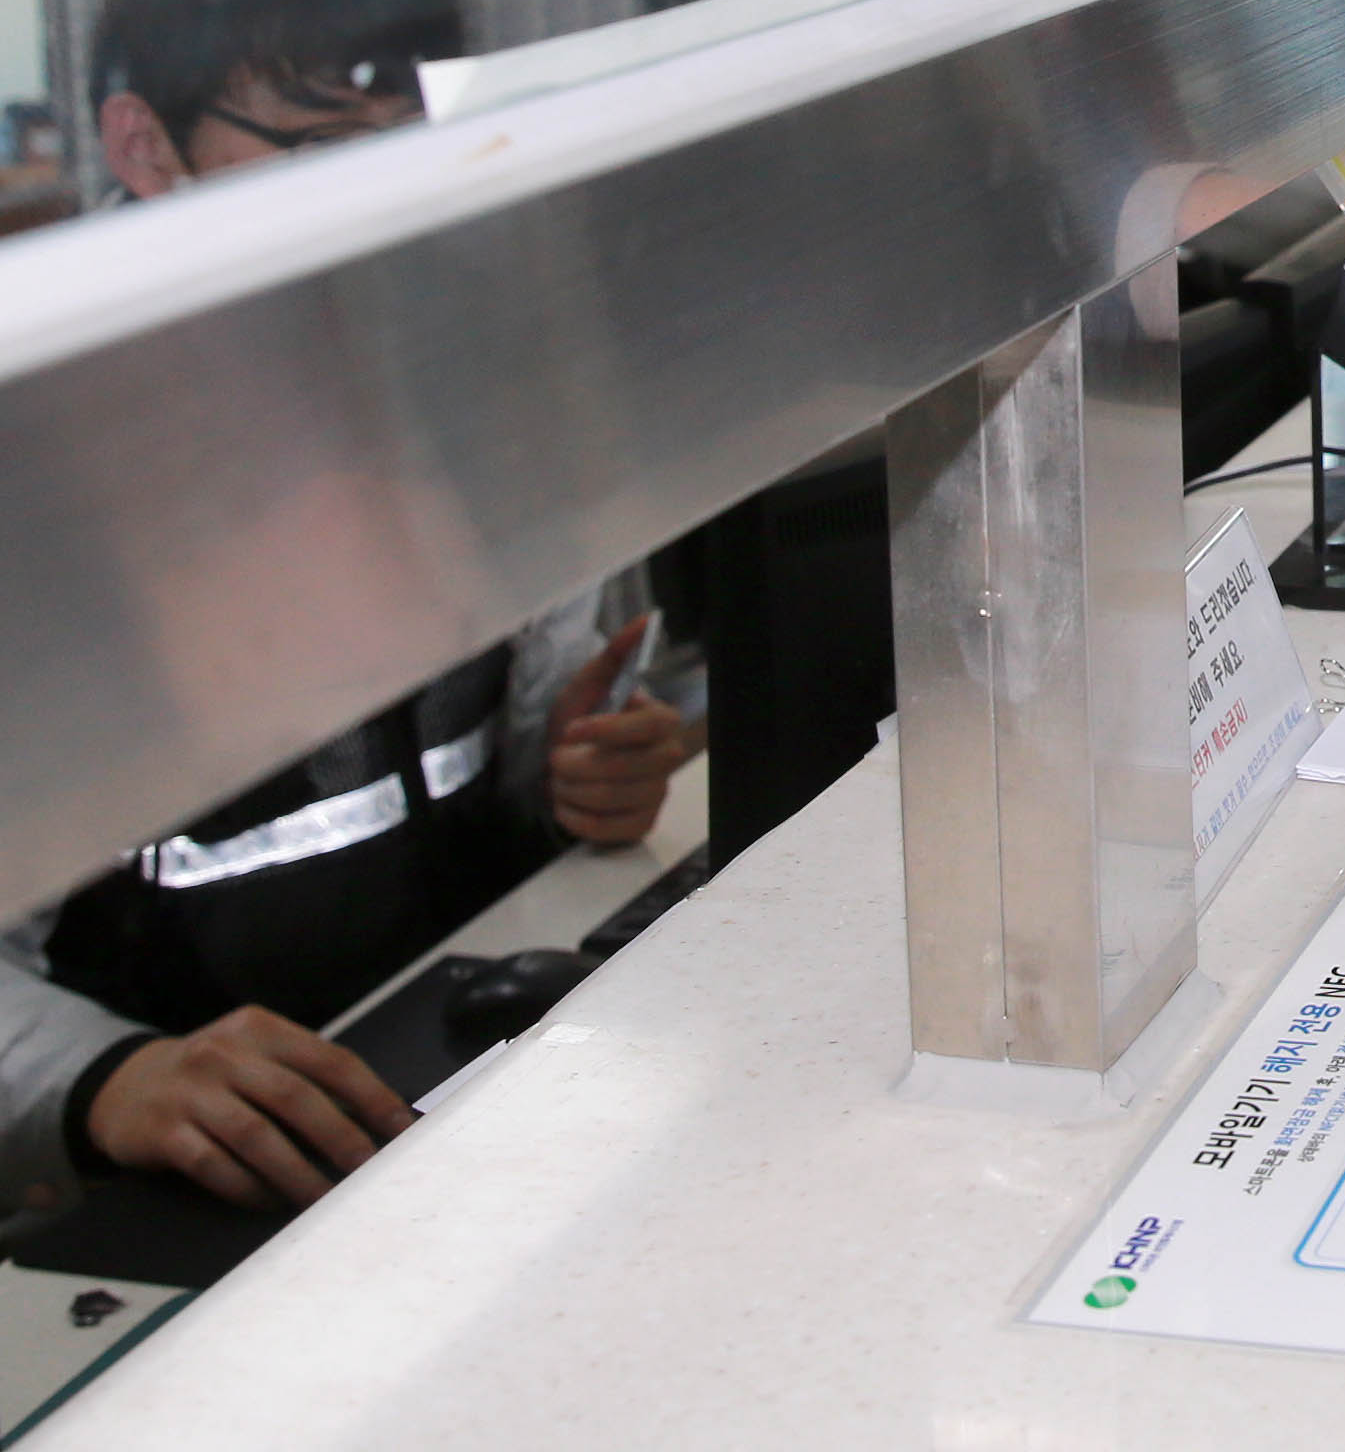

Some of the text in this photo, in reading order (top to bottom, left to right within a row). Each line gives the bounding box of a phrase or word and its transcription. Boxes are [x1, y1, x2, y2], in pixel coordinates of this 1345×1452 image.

[1288, 1003, 1341, 1034] 전용
[1260, 1039, 1318, 1073] 해지
[1193, 1078, 1292, 1169] 모바일기기
